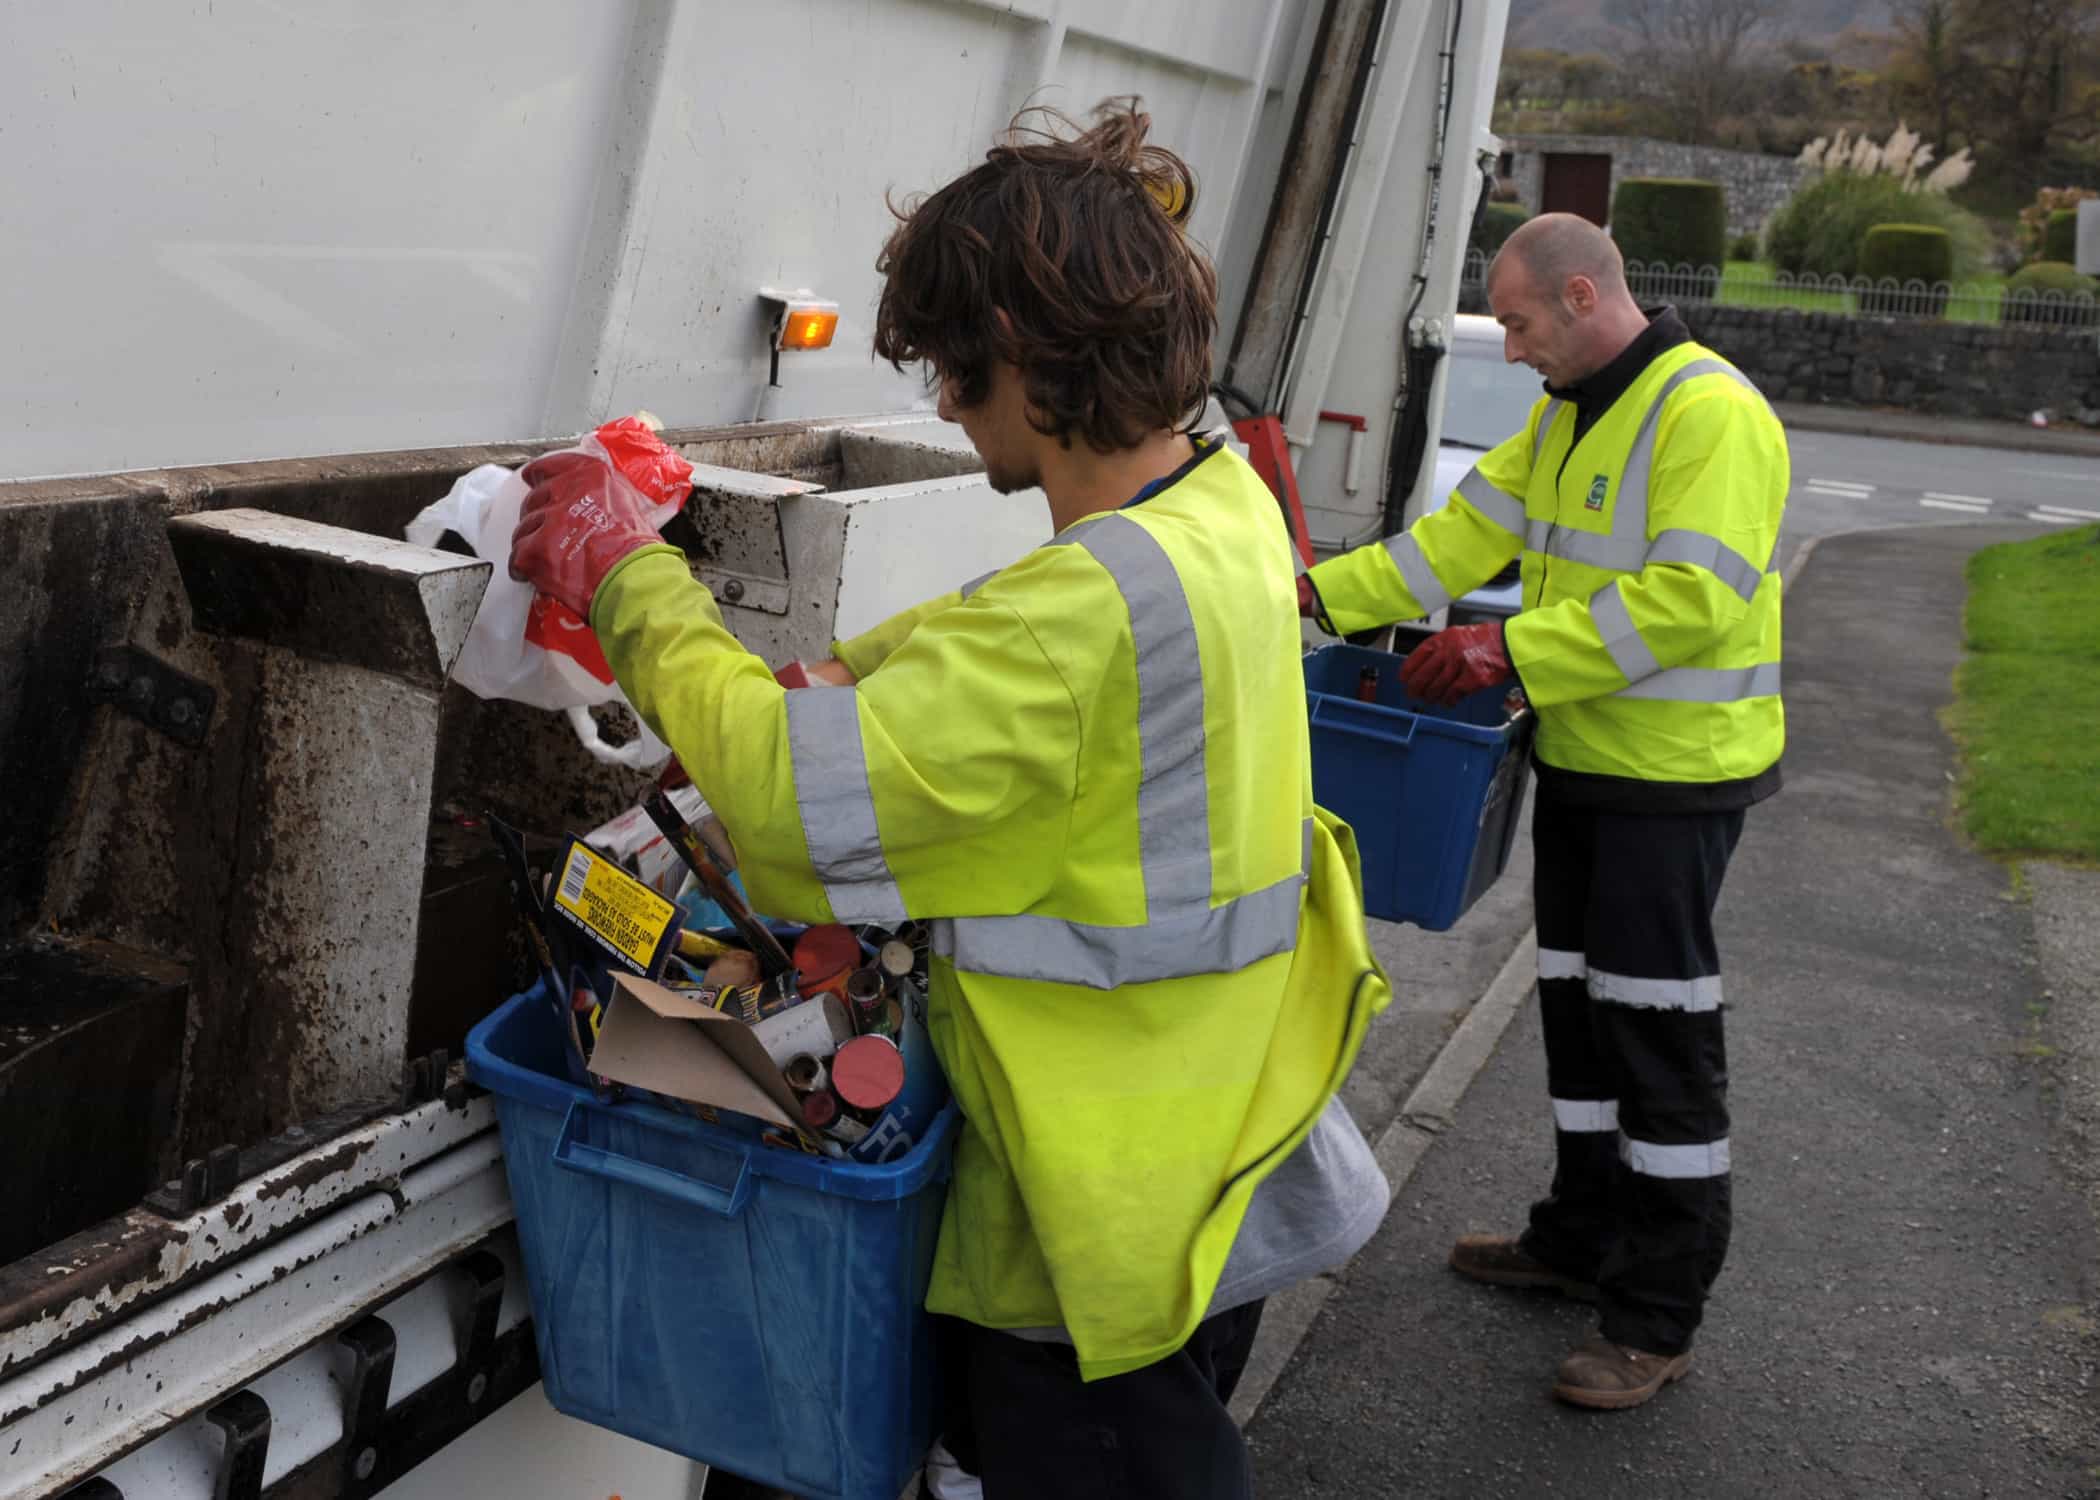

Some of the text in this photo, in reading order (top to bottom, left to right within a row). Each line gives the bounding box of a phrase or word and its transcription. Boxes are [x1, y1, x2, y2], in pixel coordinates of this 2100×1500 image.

[608, 906, 617, 920] AS
[616, 912, 632, 930] SOLD
[630, 922, 640, 936] BE
[638, 928, 657, 946] MUST
[615, 928, 640, 955] GARDEN
